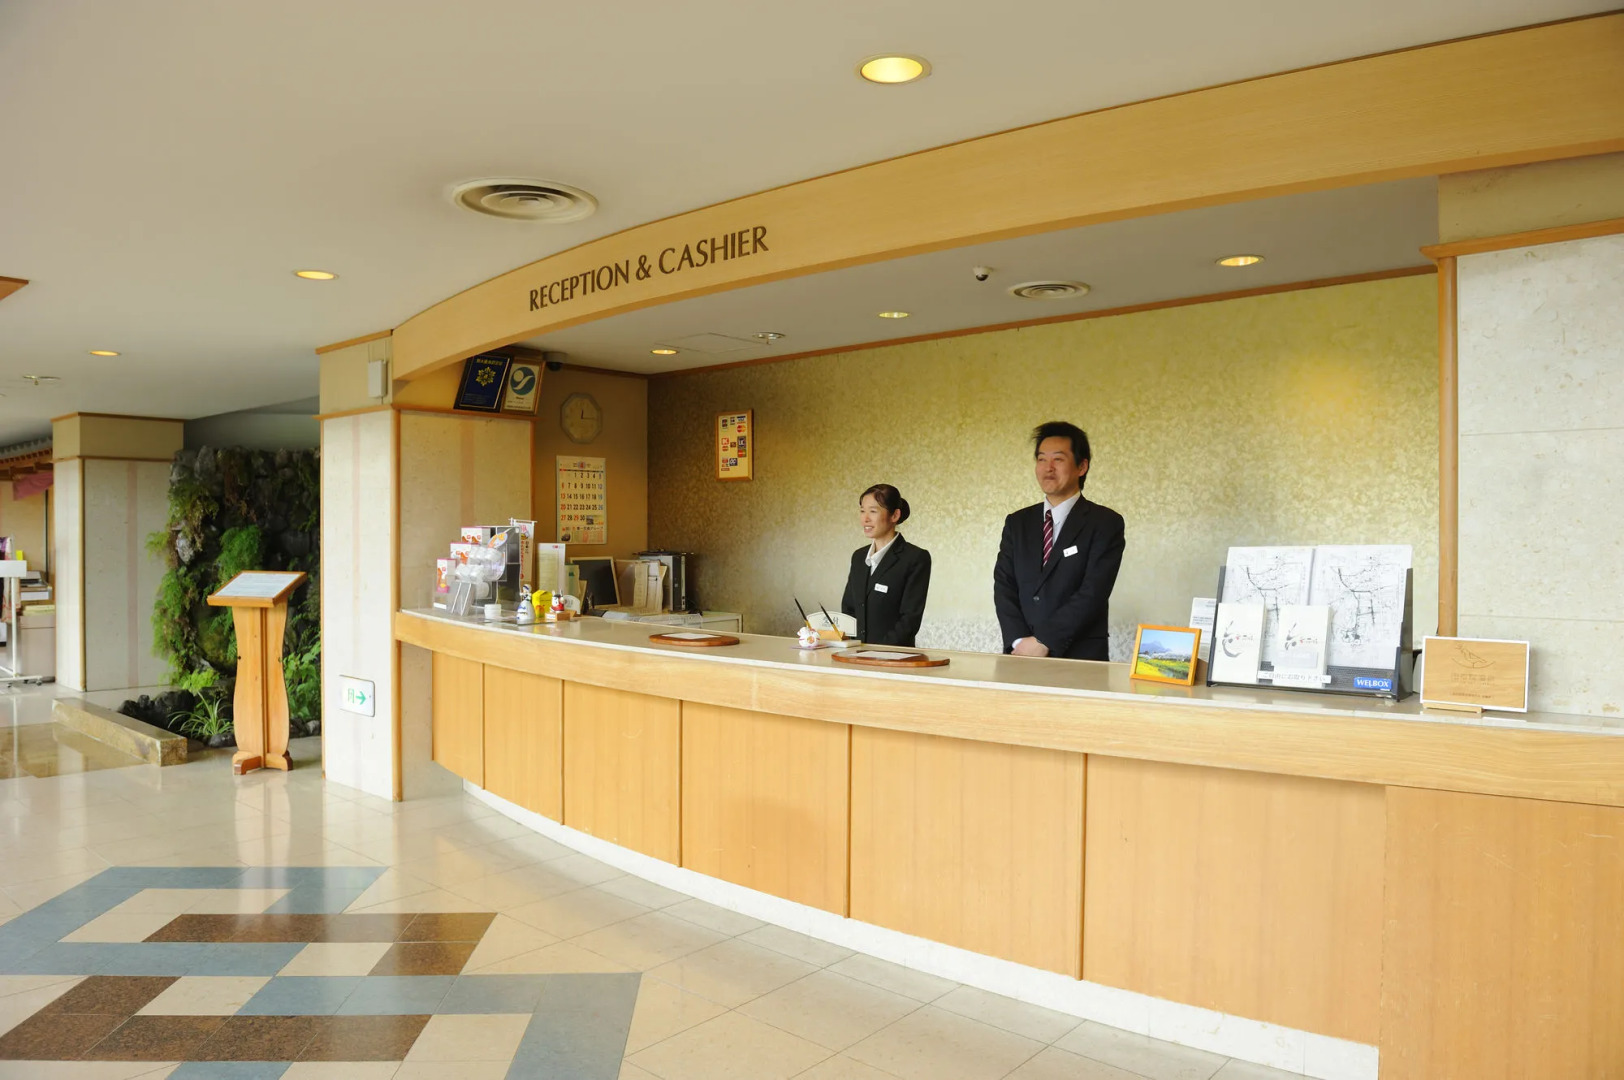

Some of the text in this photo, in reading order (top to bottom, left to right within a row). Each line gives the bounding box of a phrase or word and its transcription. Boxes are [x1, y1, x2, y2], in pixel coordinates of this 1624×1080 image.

[529, 225, 770, 312] RECEPTION & CASHIER
[1356, 679, 1389, 688] WELBOX
